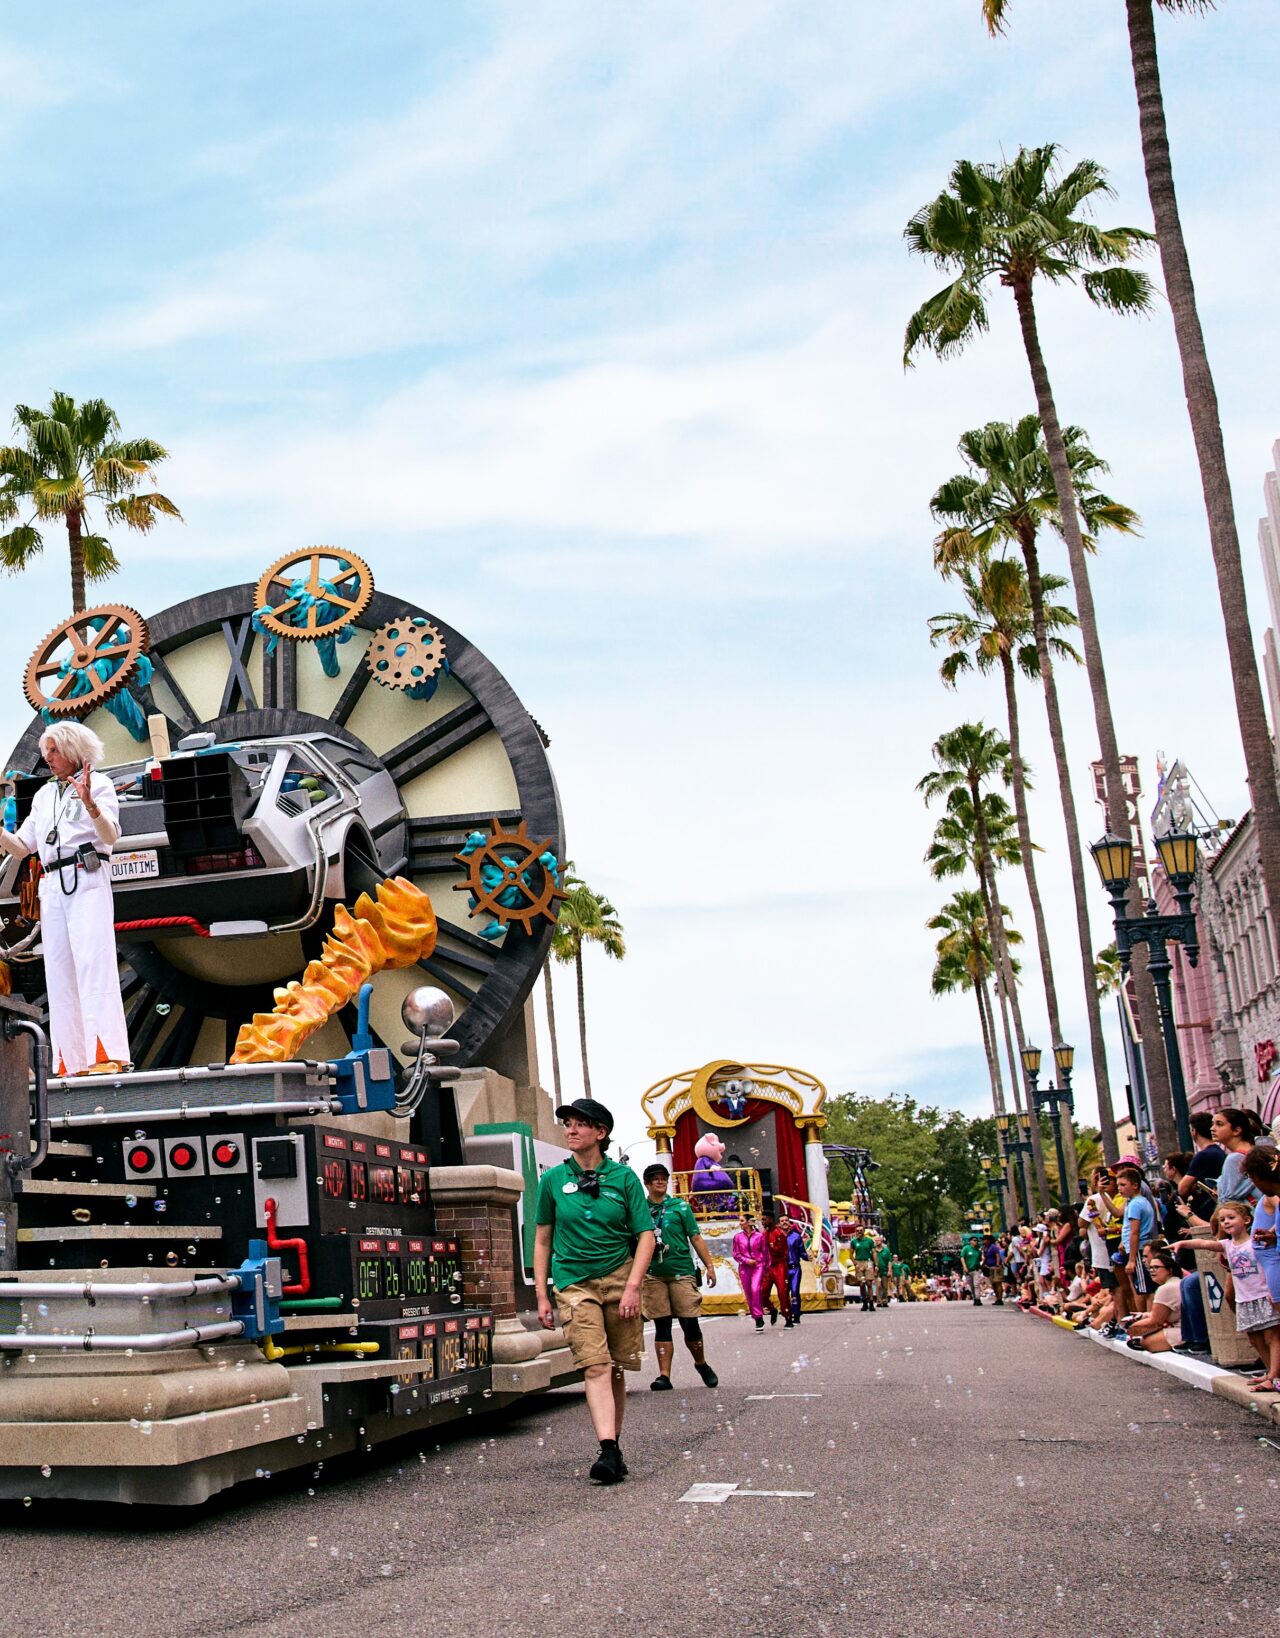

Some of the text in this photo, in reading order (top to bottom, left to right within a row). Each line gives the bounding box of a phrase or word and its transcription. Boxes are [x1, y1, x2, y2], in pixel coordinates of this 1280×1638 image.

[111, 860, 157, 876] OUTATIME
[324, 1161, 345, 1197] NOV
[365, 1227, 403, 1237] DESTINATION TIME
[389, 1242, 397, 1250] DAY
[360, 1261, 379, 1298] OCT
[386, 1260, 399, 1296] 26
[407, 1260, 427, 1293] 1985
[402, 1305, 430, 1317] PRESENT TIME
[430, 1393, 440, 1404] LAST
[440, 1390, 450, 1401] TIME
